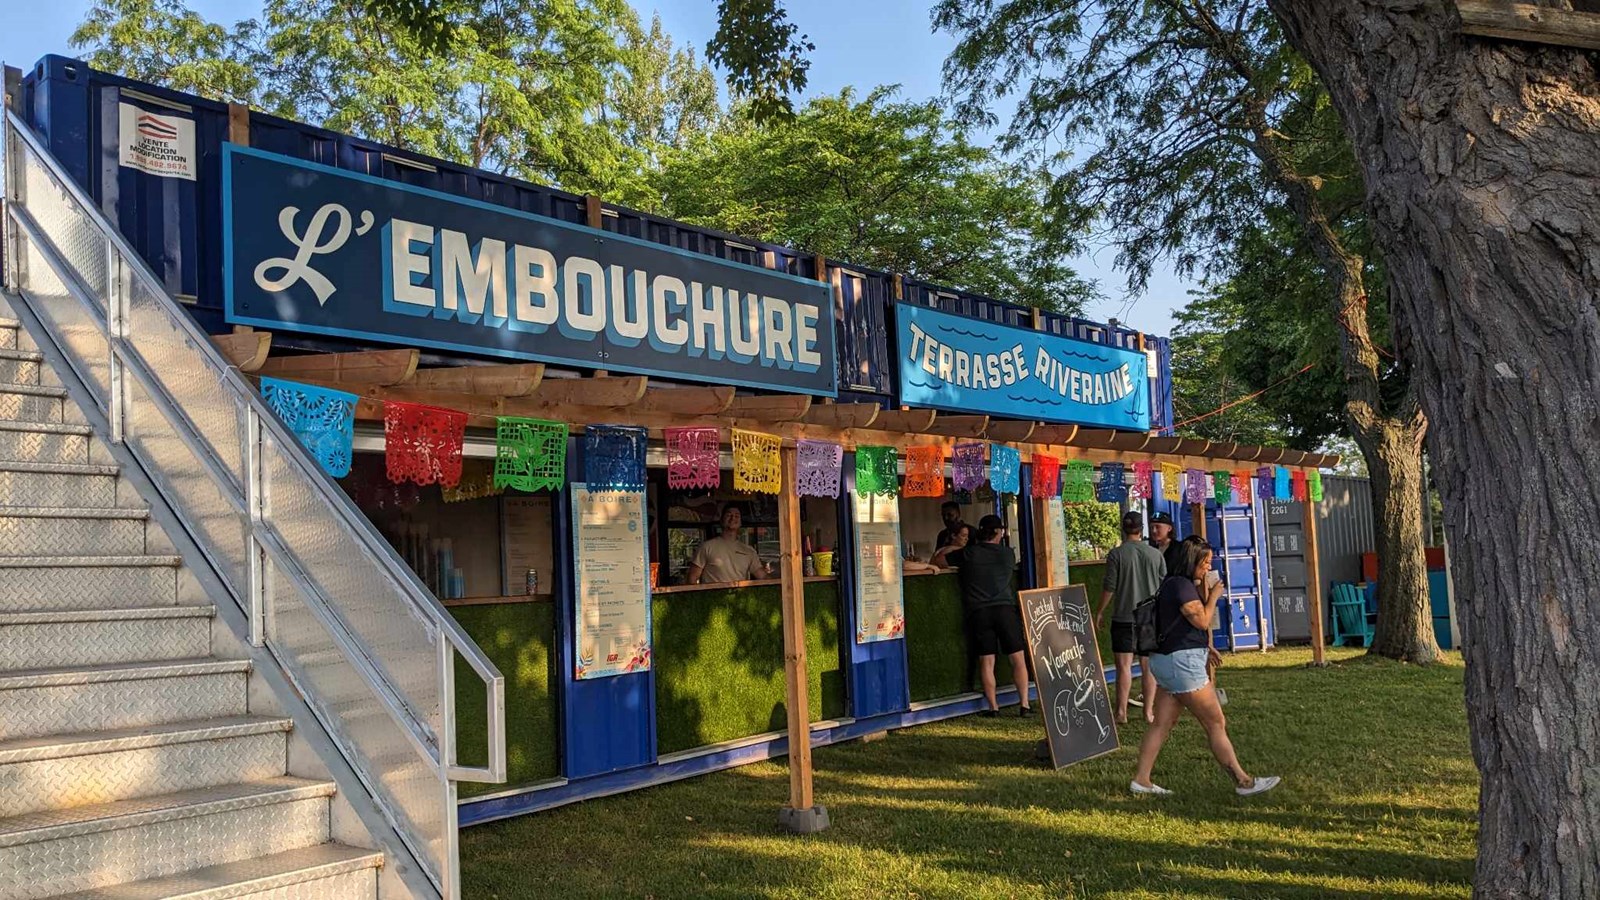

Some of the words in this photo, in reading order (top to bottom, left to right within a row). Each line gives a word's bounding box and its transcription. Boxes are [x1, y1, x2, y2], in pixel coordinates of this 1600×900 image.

[138, 141, 177, 155] LOCATION
[142, 137, 169, 148] VENTE
[129, 144, 187, 163] MODIFICATION
[908, 320, 1030, 390] TERRASSE
[1034, 345, 1135, 406] RIVERAINE
[599, 496, 632, 504] BOIRE
[1271, 505, 1288, 515] 22G1
[1026, 596, 1055, 622] Cocktail
[1041, 636, 1086, 681] Margarita
